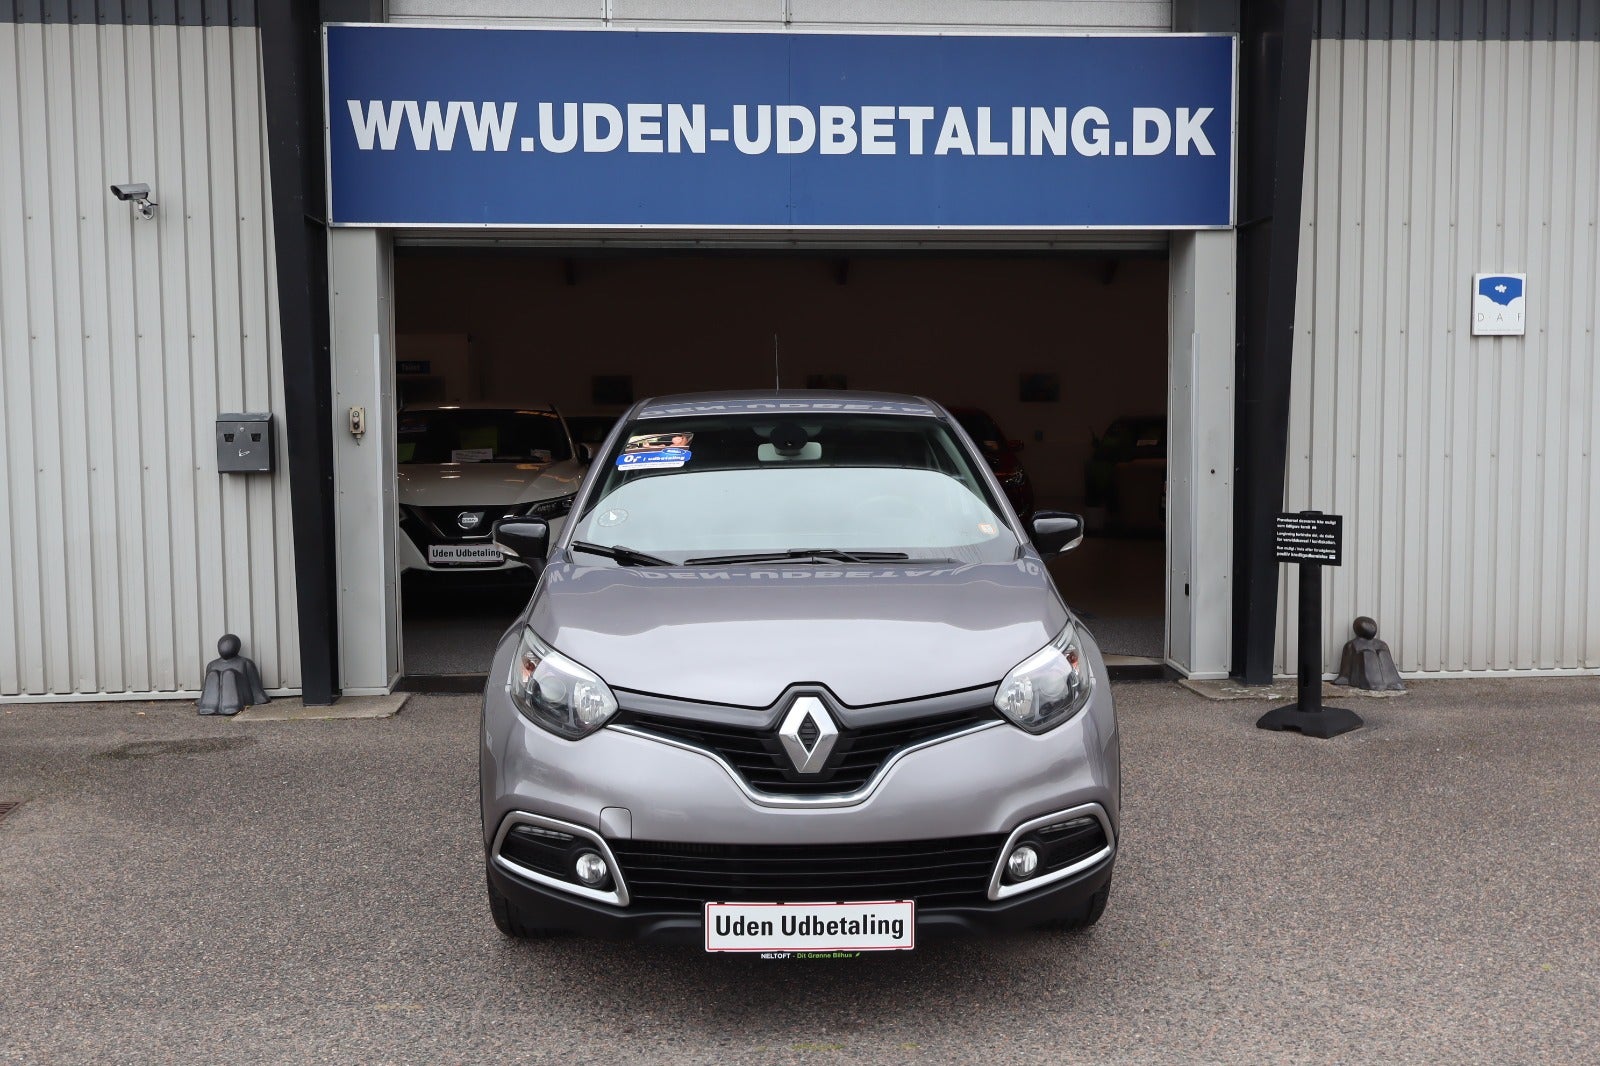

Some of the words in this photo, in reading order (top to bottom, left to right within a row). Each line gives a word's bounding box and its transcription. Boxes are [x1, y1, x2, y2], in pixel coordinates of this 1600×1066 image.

[347, 100, 1216, 157] WWW.UDEN-UDBETALING.DK
[432, 549, 454, 557] Uden
[456, 549, 501, 558] Udbetaling
[715, 915, 773, 936] Uden
[781, 914, 904, 939] Udbetaling
